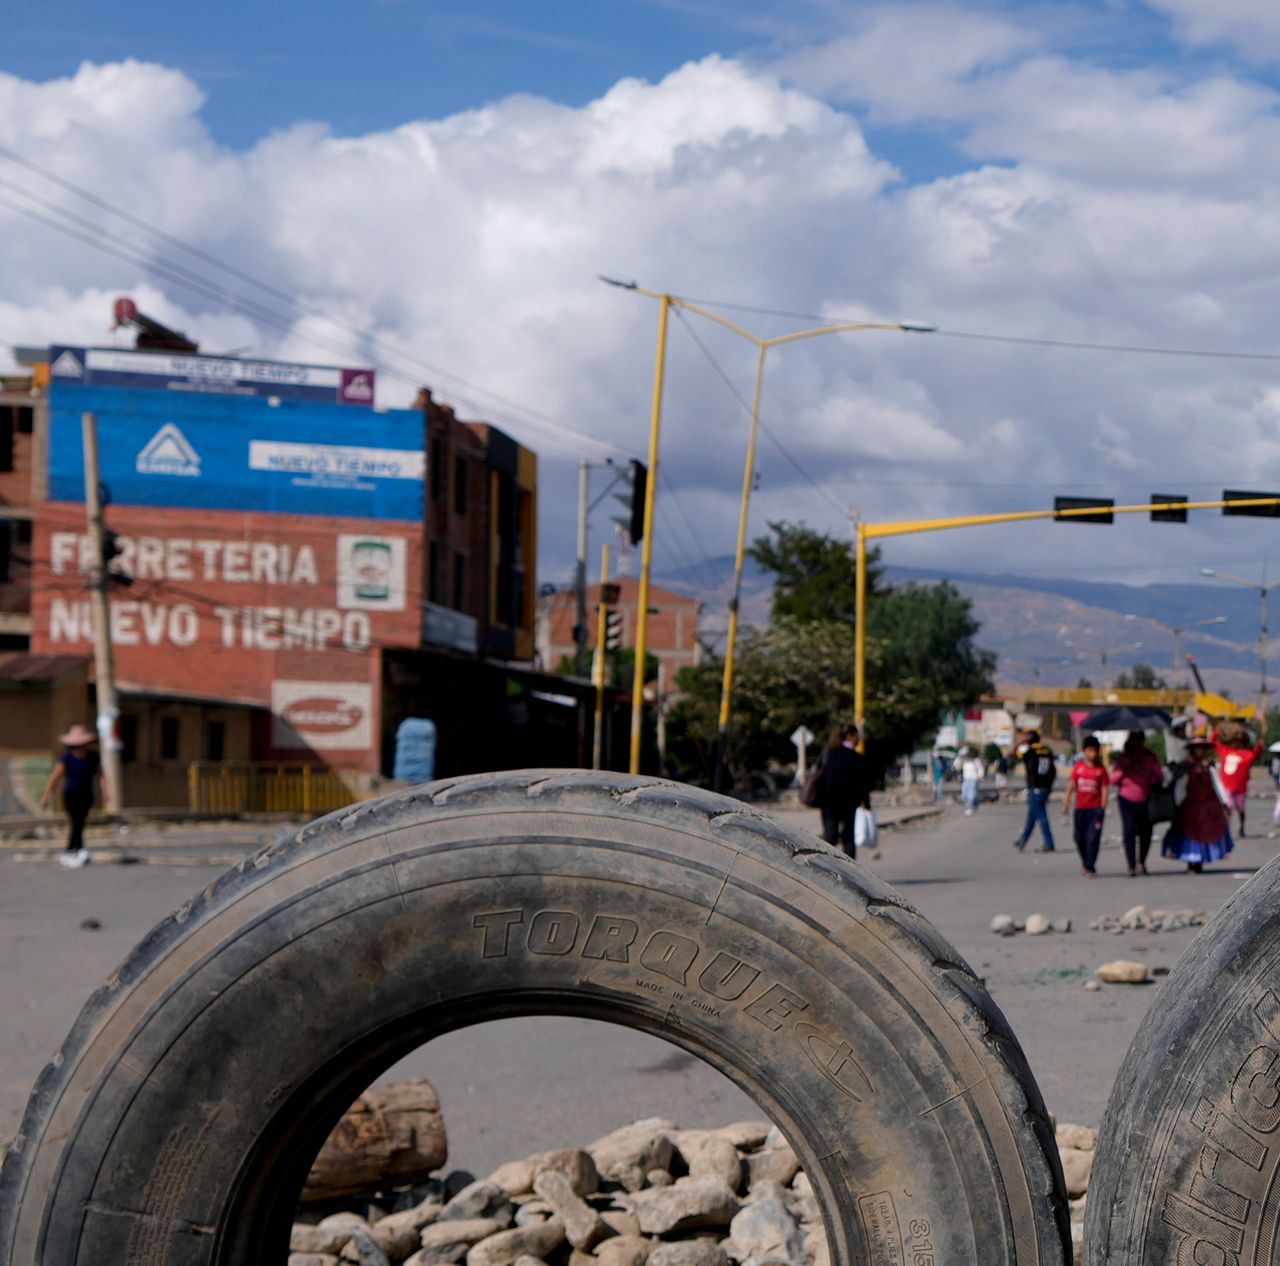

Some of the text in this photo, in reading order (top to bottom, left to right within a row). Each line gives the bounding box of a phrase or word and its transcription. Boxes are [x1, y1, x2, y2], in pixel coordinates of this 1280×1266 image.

[242, 363, 309, 382] TIEMPO
[335, 458, 401, 476] TIEMPO
[214, 606, 372, 652] TIEMPO
[473, 909, 811, 1032] TORQUE
[636, 978, 720, 1019] MADE IN CHINA
